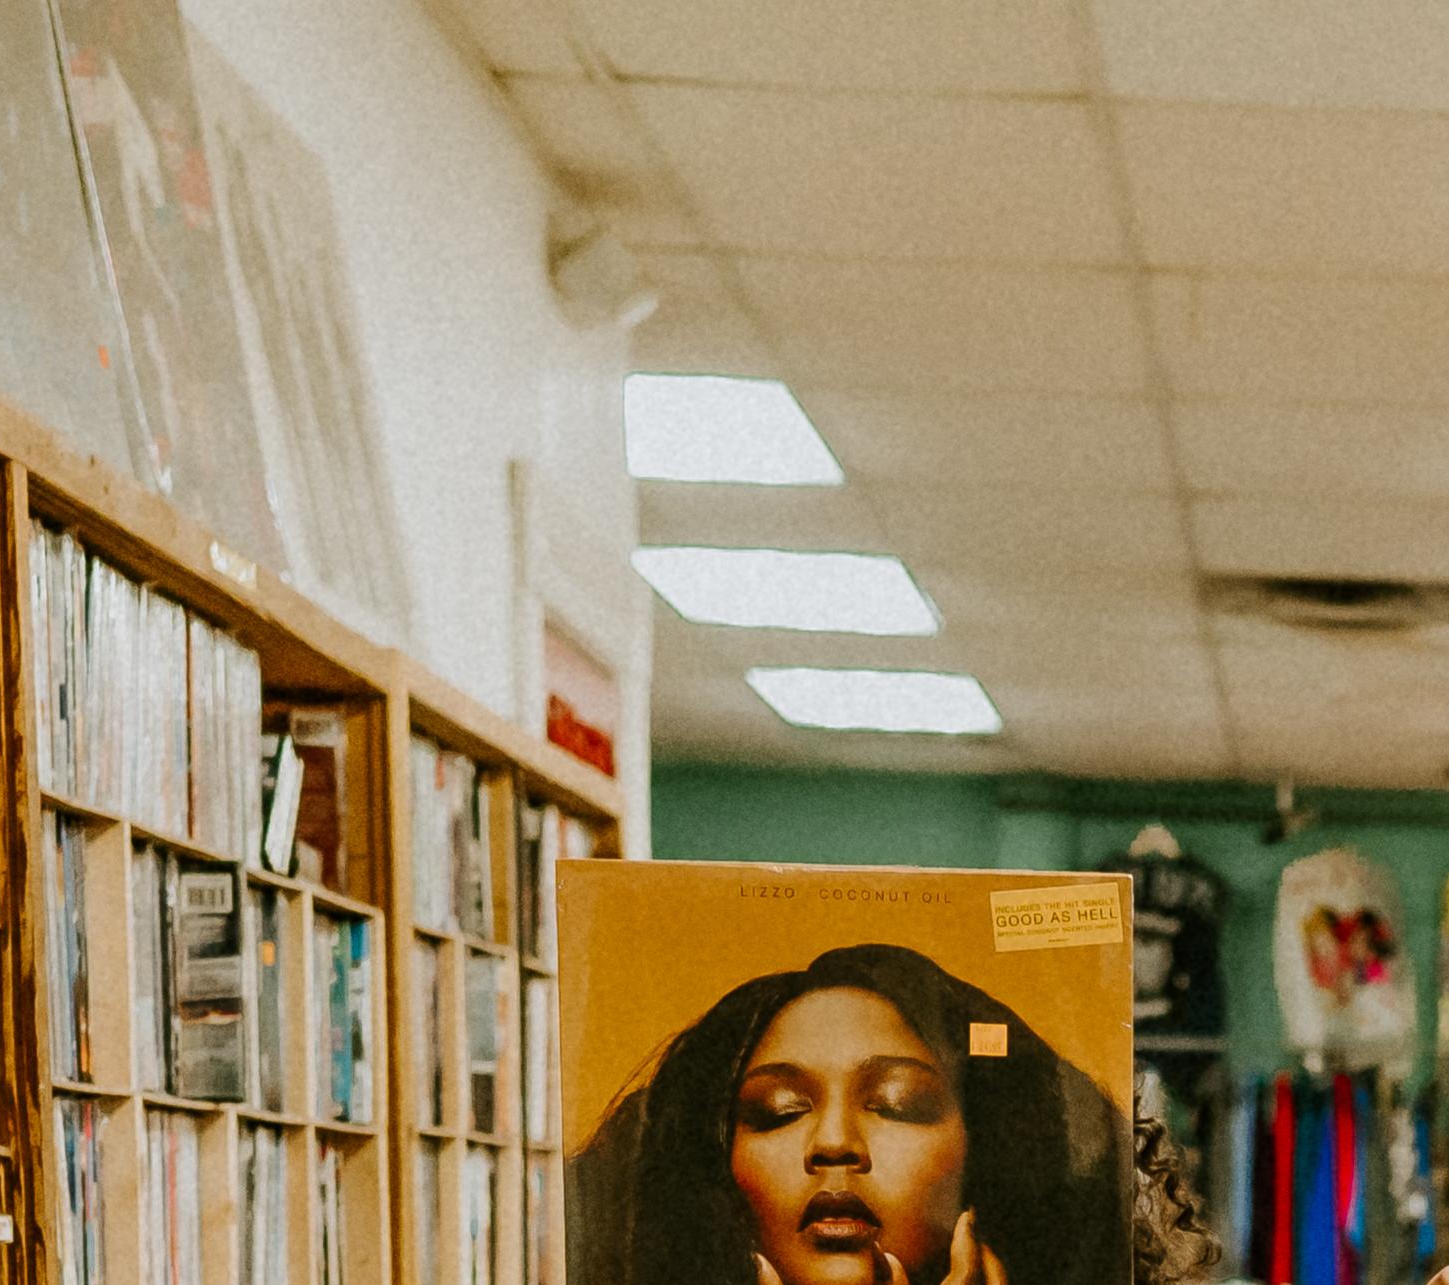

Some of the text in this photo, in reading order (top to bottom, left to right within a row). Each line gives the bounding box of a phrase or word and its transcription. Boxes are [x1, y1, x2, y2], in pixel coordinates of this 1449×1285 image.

[739, 885, 952, 904] LIZZO COCONUT OIL
[995, 903, 1041, 914] INCLUDES
[1044, 902, 1061, 911] THE
[1064, 901, 1080, 909] HIT
[995, 908, 1119, 928] GOOD AS HELL
